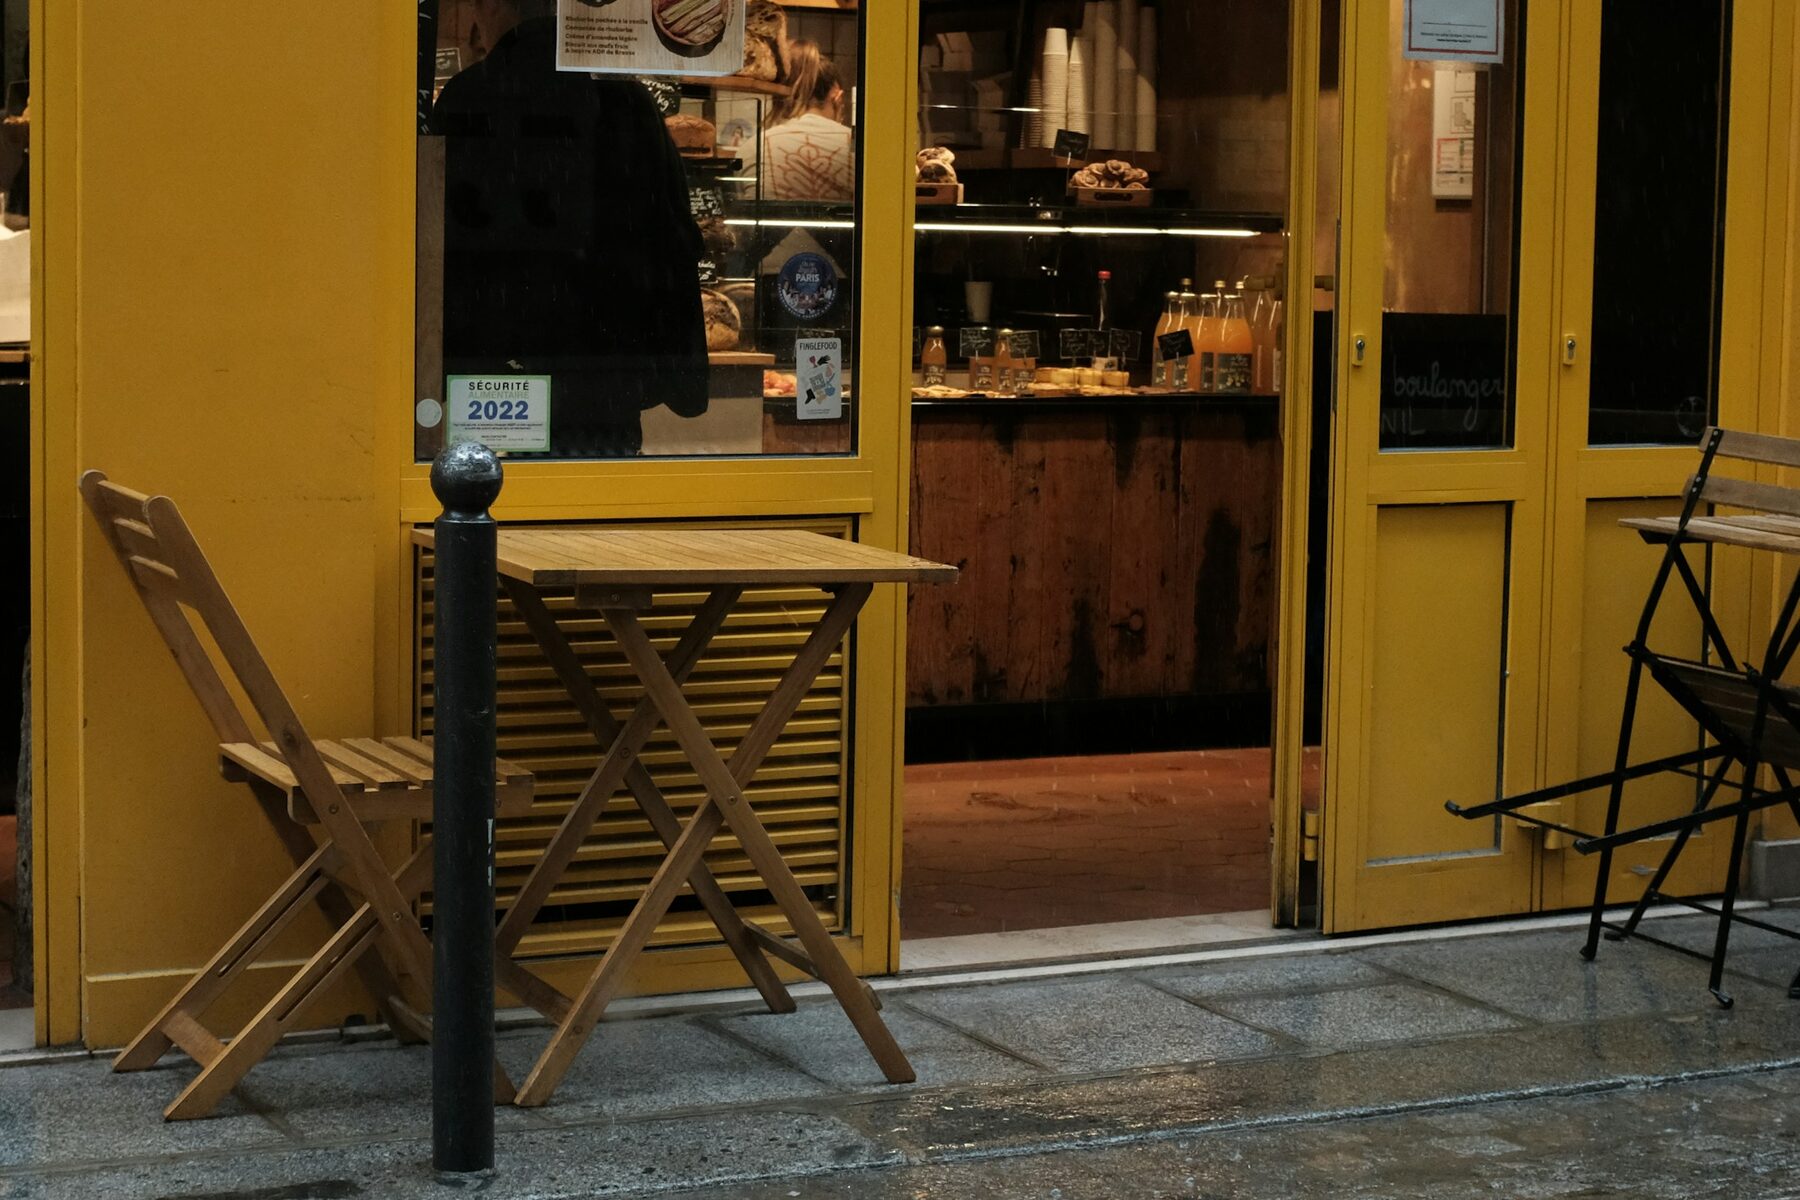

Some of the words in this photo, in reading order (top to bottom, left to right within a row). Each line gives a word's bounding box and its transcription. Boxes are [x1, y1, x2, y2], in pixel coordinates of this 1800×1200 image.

[795, 273, 820, 282] PARIS
[468, 380, 529, 391] SÉCURITÉ
[468, 400, 529, 420] 2022
